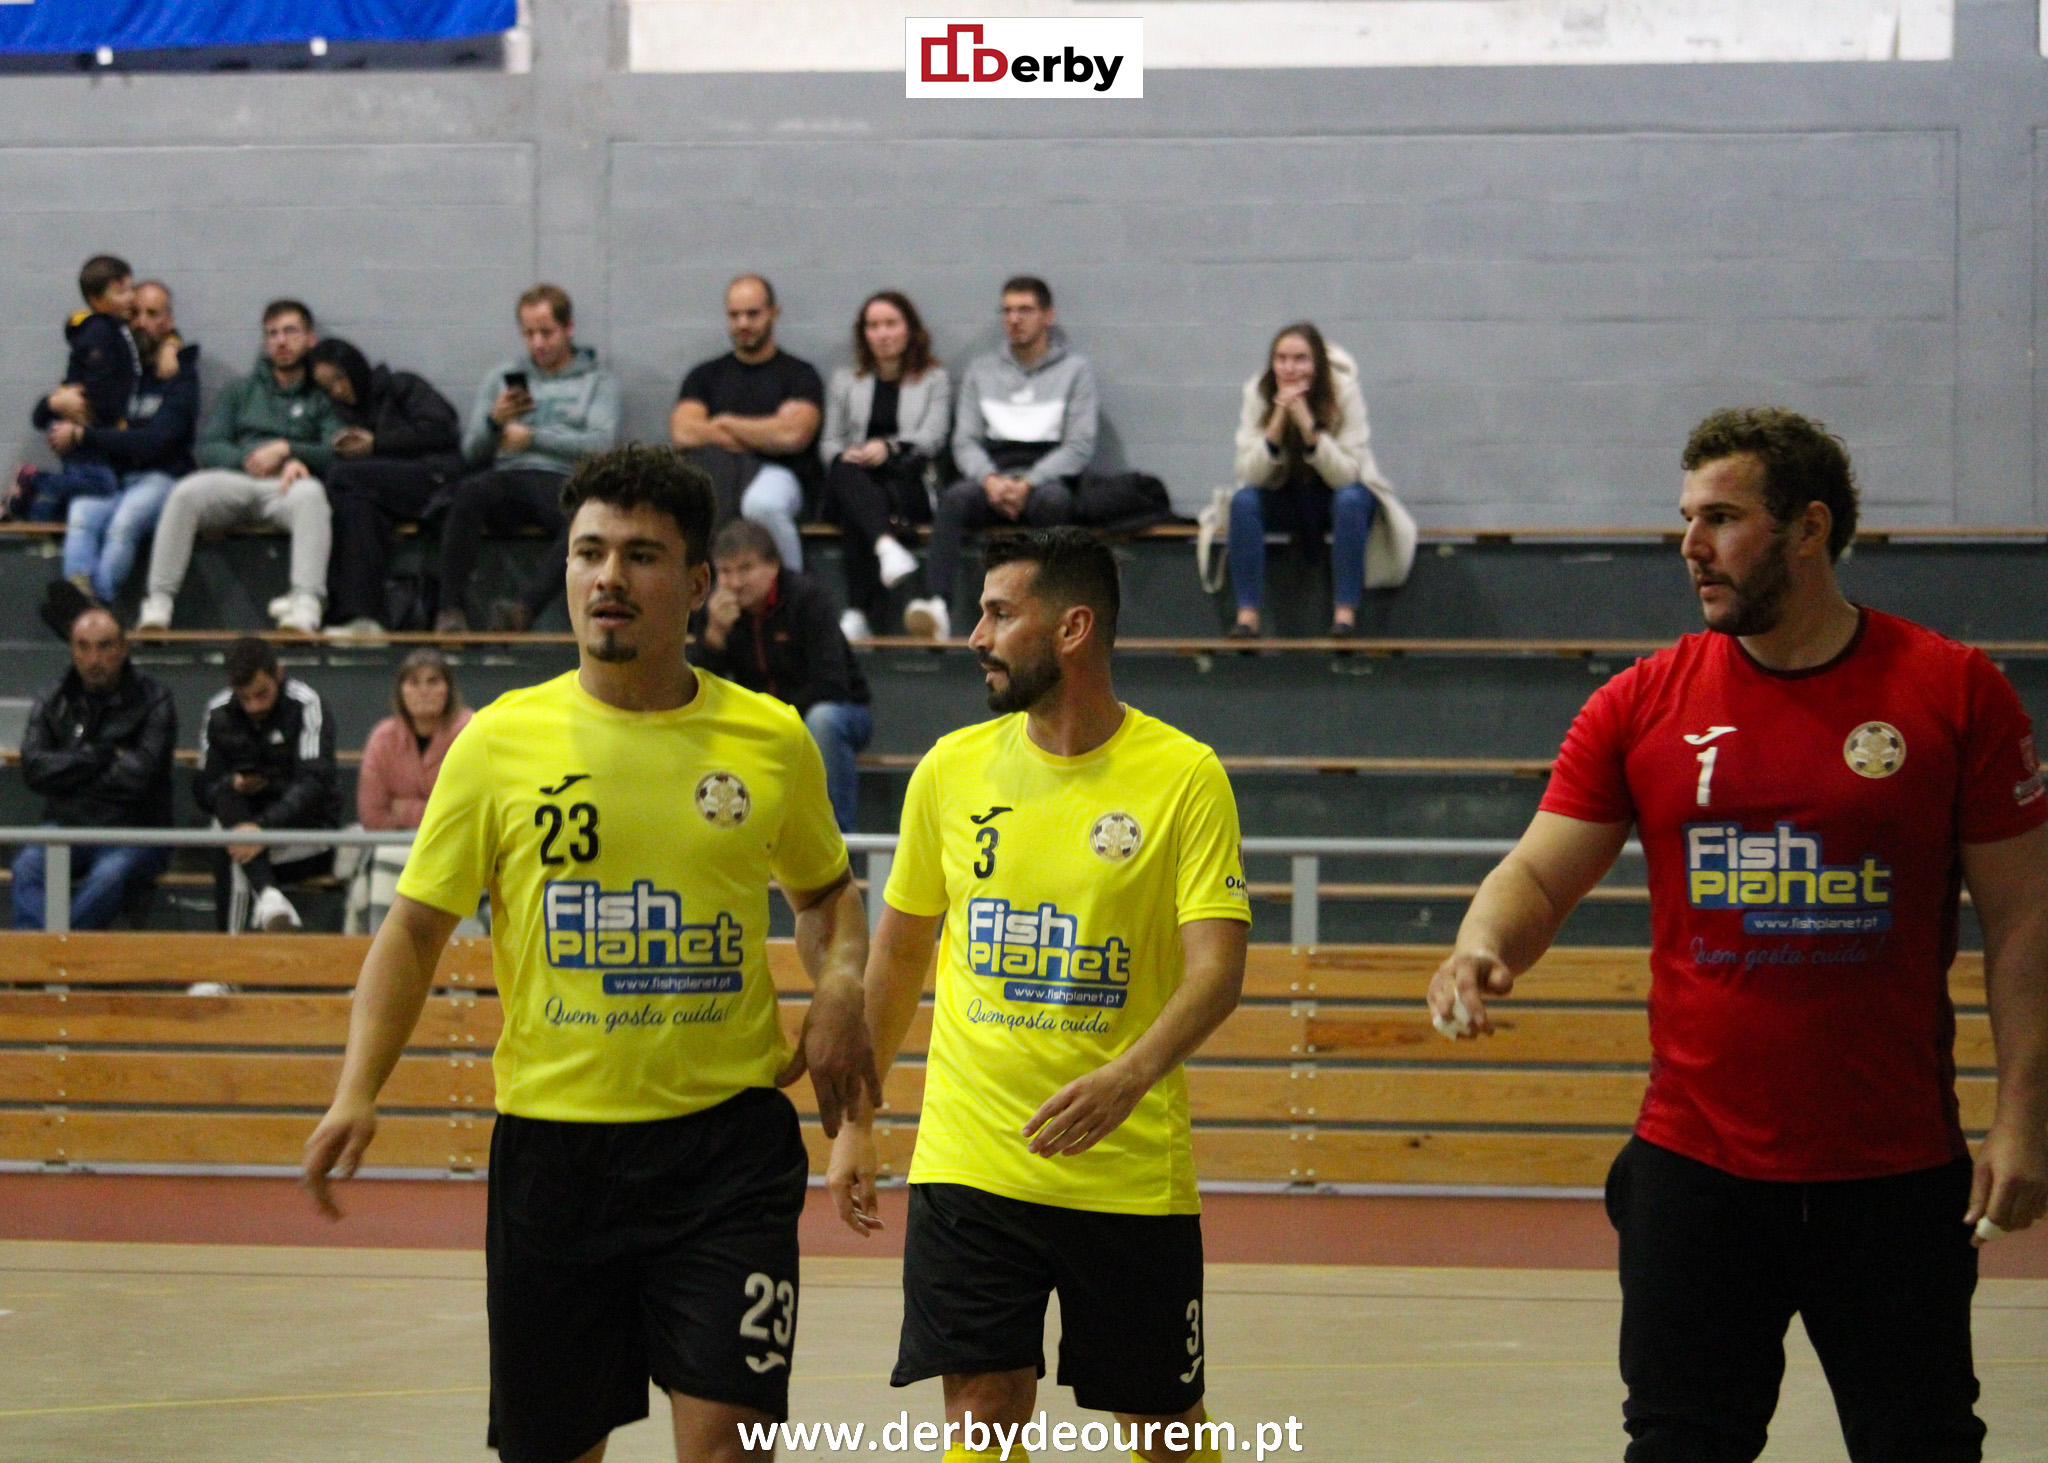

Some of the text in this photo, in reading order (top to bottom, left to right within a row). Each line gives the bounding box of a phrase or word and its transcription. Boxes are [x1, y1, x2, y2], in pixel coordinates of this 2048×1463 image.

[1696, 747, 1718, 807] 1
[535, 803, 599, 866] 23
[973, 827, 999, 880] 3
[1688, 826, 1818, 870] Fish
[547, 883, 676, 929] Fish
[970, 902, 1074, 948] Fish
[1754, 914, 1878, 931] www.fishplanet.pt
[614, 976, 731, 992] www.fishplanet.pt
[1014, 986, 1120, 1005] www.fishplanet.pt
[546, 998, 598, 1026] Quem
[605, 1002, 666, 1033] gosta
[966, 999, 1005, 1024] Quem
[739, 1272, 795, 1347] 23
[1186, 1298, 1200, 1356] 3
